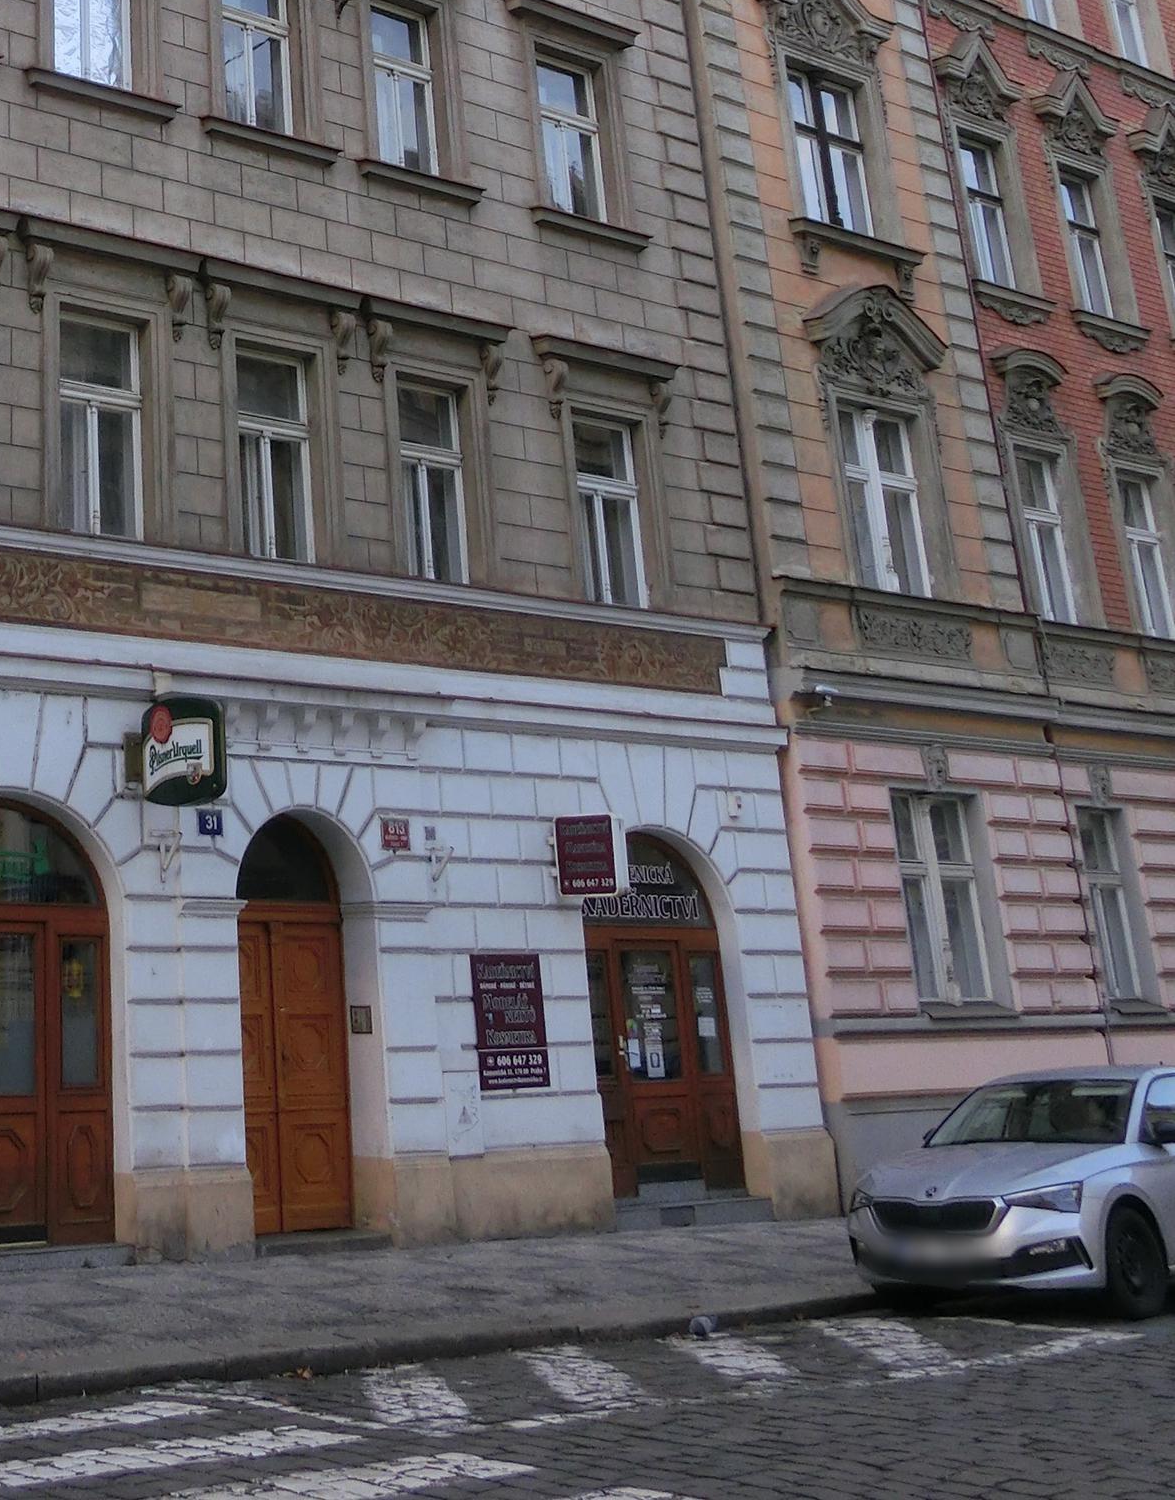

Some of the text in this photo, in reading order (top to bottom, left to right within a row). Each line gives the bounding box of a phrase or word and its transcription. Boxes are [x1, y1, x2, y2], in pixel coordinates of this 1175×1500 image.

[149, 739, 202, 776] Pilsner Urquell
[205, 815, 218, 830] 31
[629, 861, 674, 885] ENICKÁ
[572, 878, 585, 889] 606
[587, 878, 599, 888] 647
[496, 1054, 542, 1067] 606 647 329
